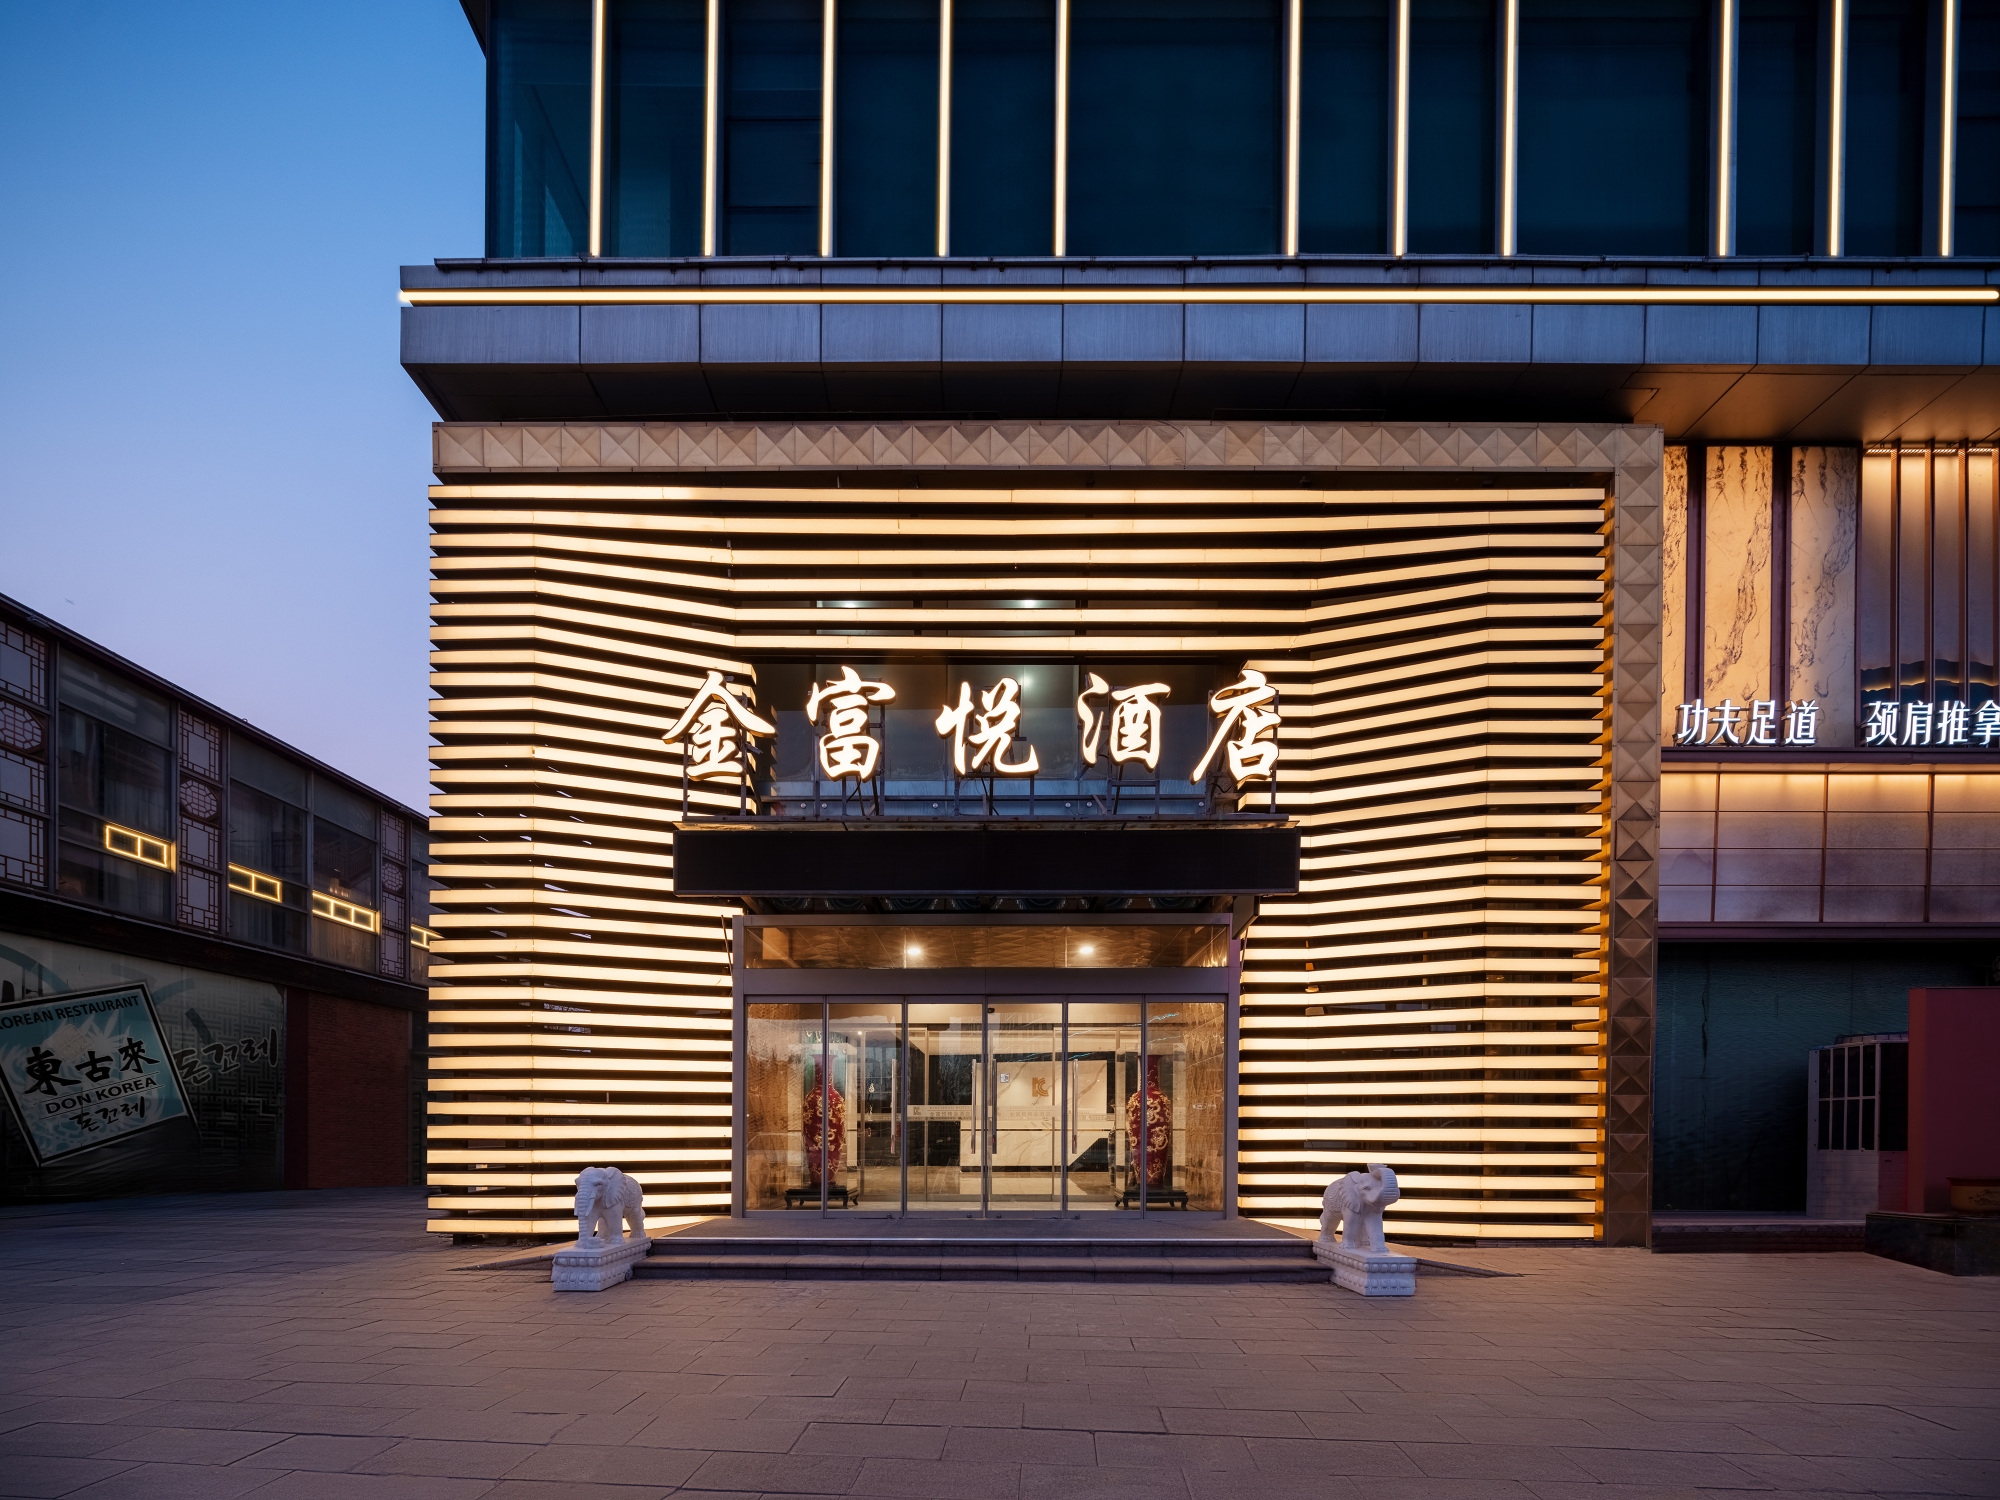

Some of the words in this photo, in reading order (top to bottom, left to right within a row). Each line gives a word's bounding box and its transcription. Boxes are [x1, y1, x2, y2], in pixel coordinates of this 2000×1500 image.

[662, 666, 1283, 788] 金富悦酒店
[1677, 698, 1820, 745] 功夫足道
[1866, 700, 2000, 746] 颈肩推拿
[55, 995, 140, 1020] RESTAURANT
[46, 1093, 92, 1115] DON
[97, 1077, 158, 1101] KOREA
